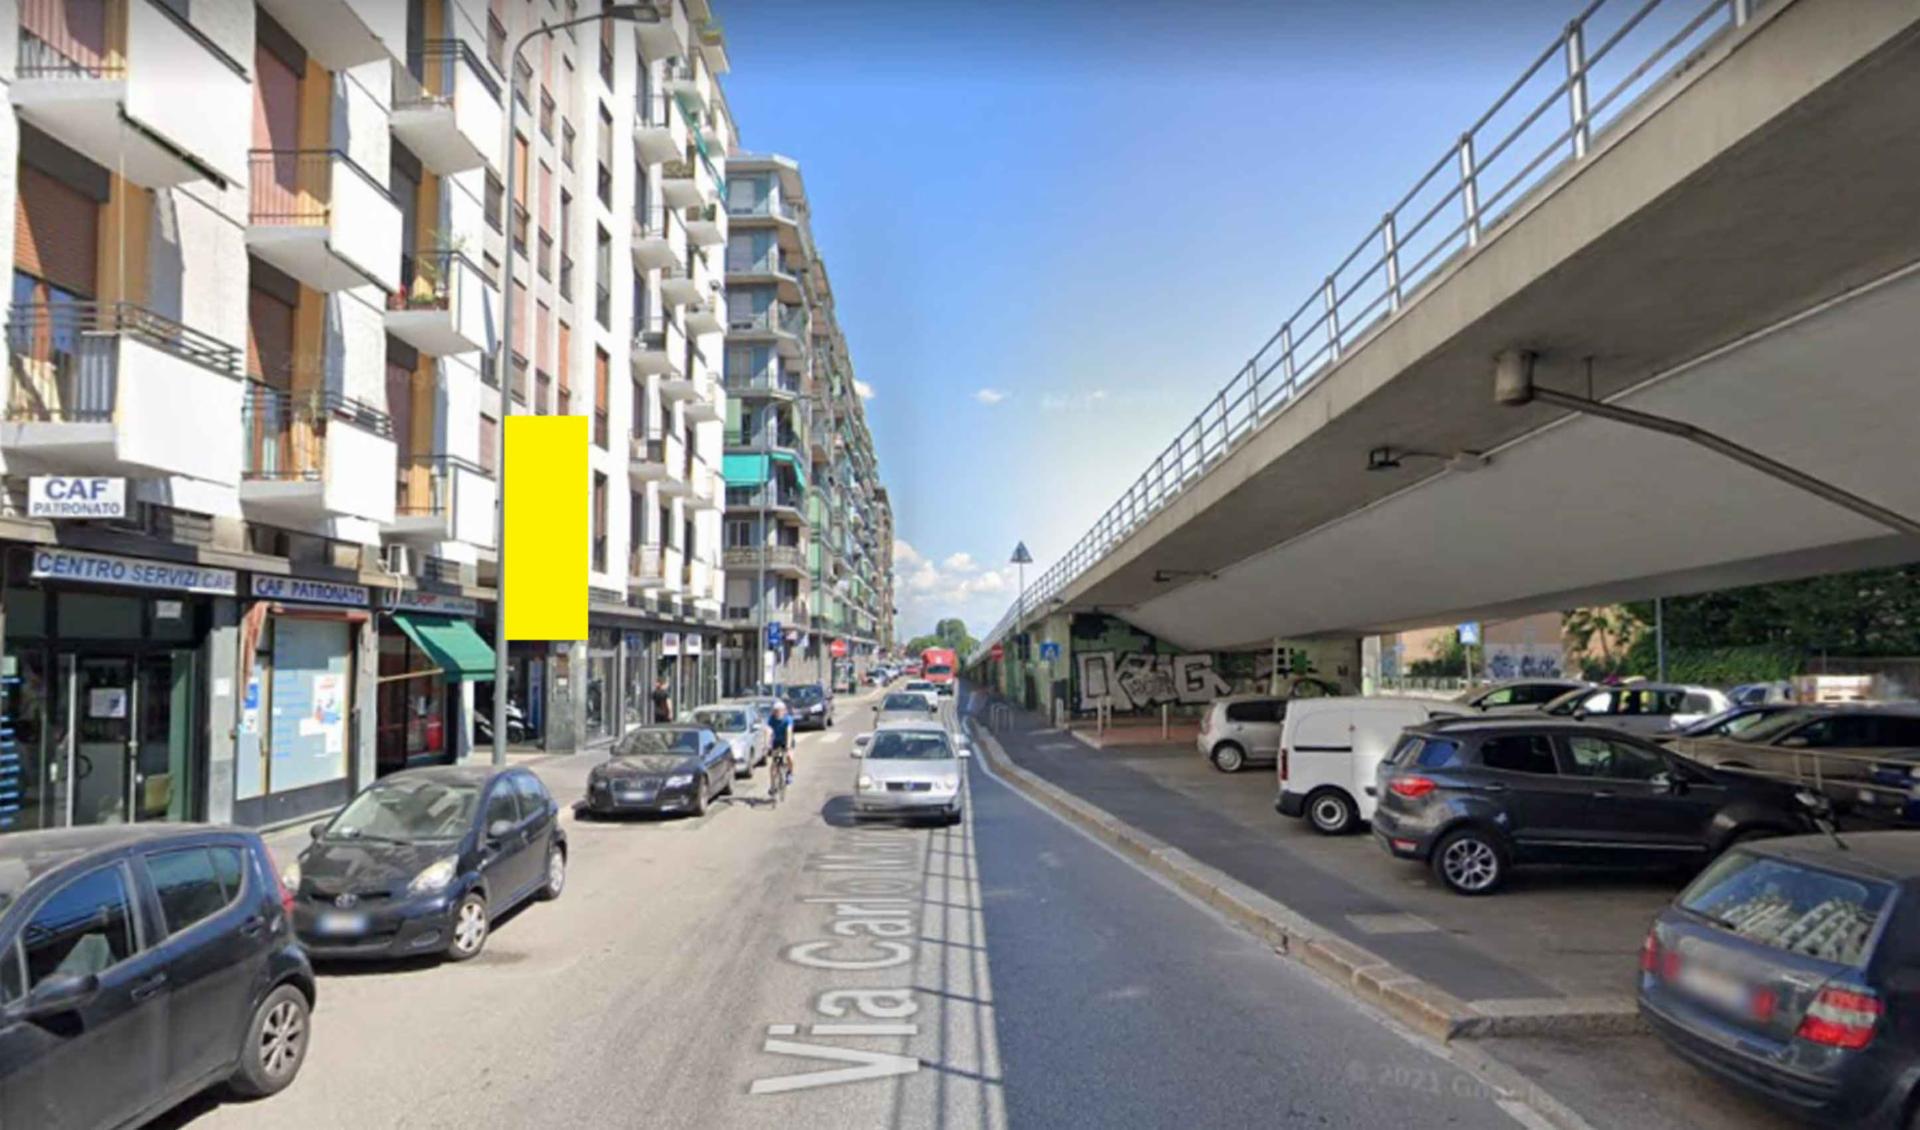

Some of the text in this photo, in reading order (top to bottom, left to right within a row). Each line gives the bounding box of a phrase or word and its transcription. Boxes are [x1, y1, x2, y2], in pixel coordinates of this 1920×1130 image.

[45, 478, 109, 501] CAF
[33, 501, 121, 515] PATRONATO
[36, 552, 233, 590] CENTRO SERVIZI CAF
[255, 577, 284, 597] CAF
[290, 580, 366, 606] PATRONATO
